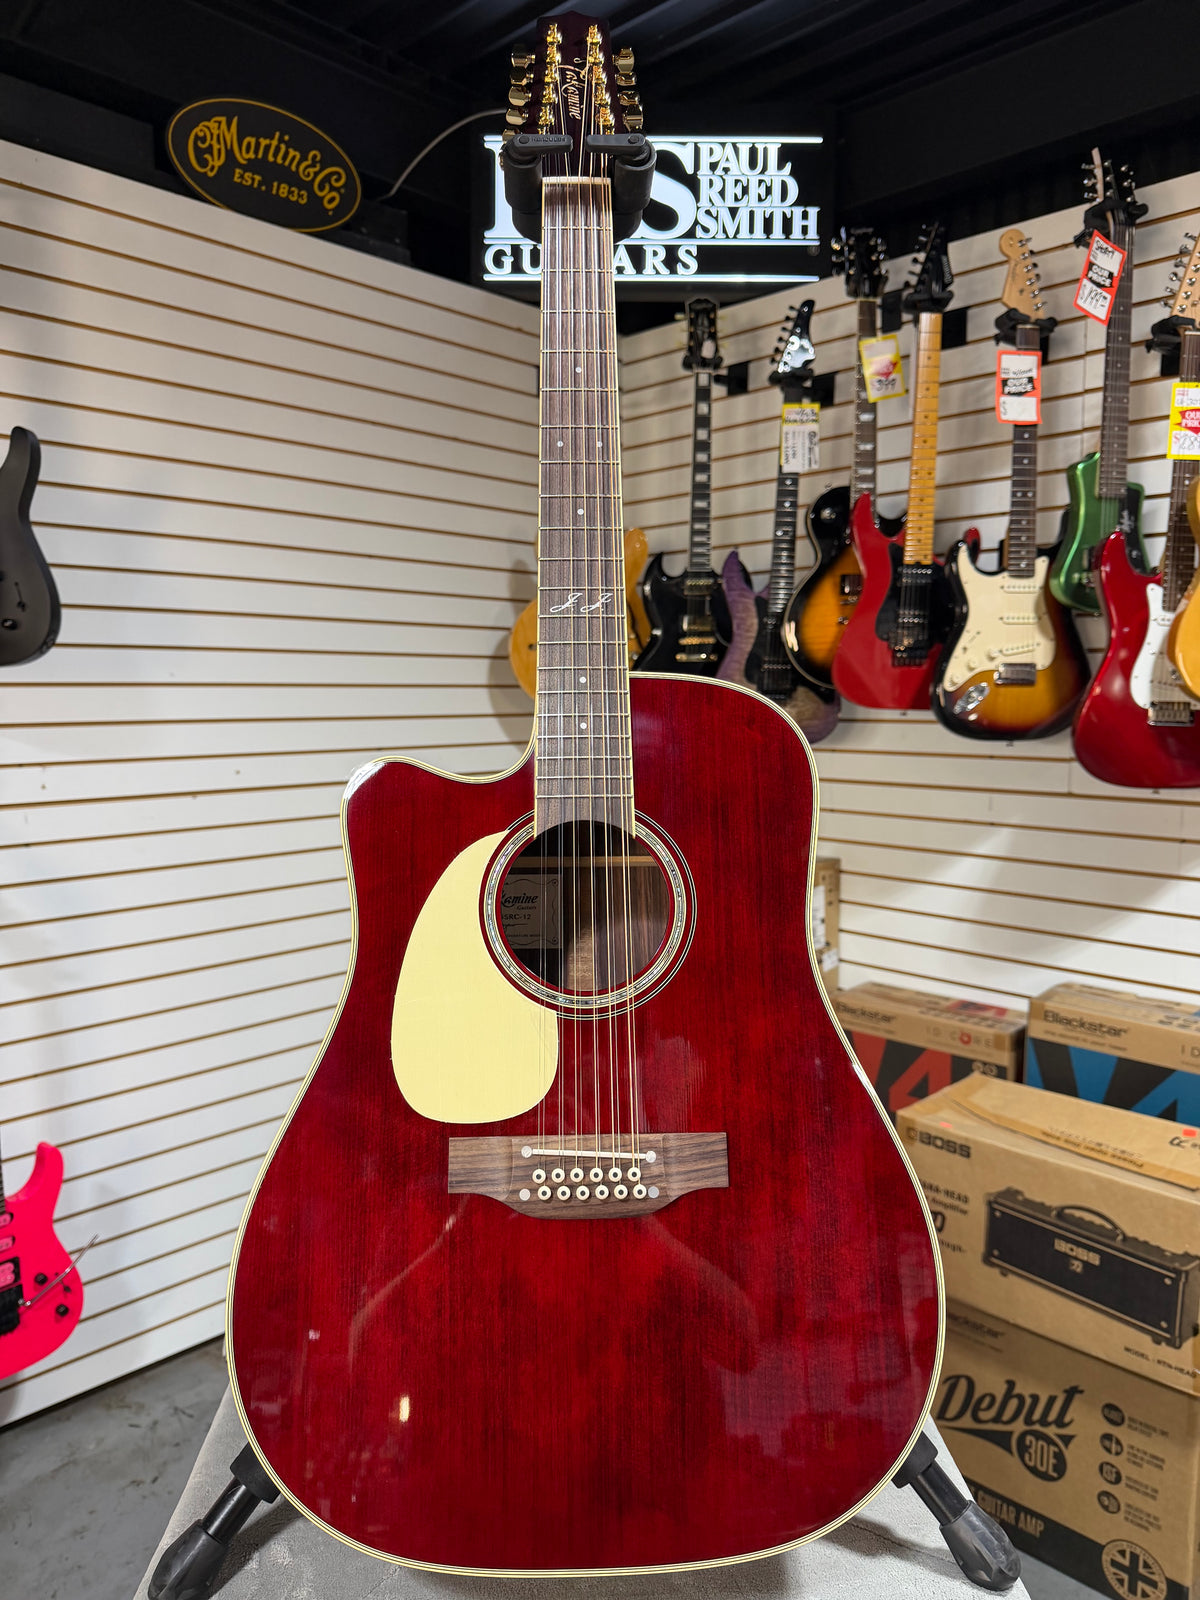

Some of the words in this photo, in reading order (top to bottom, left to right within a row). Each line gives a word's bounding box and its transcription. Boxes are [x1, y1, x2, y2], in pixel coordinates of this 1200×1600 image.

[696, 142, 792, 176] PAUL
[233, 168, 266, 192] EST.
[271, 181, 308, 205] 1833
[696, 175, 799, 207] REED
[695, 206, 821, 240] SMITH
[483, 244, 699, 276] GUARS
[1184, 410, 1200, 420] OU
[501, 913, 532, 921] SRC-12
[1043, 1009, 1128, 1038] Blackstar
[918, 1130, 972, 1159] BOSS
[935, 1373, 1085, 1429] Debut
[1022, 1434, 1059, 1478] 30E
[1018, 1511, 1045, 1539] AMP
